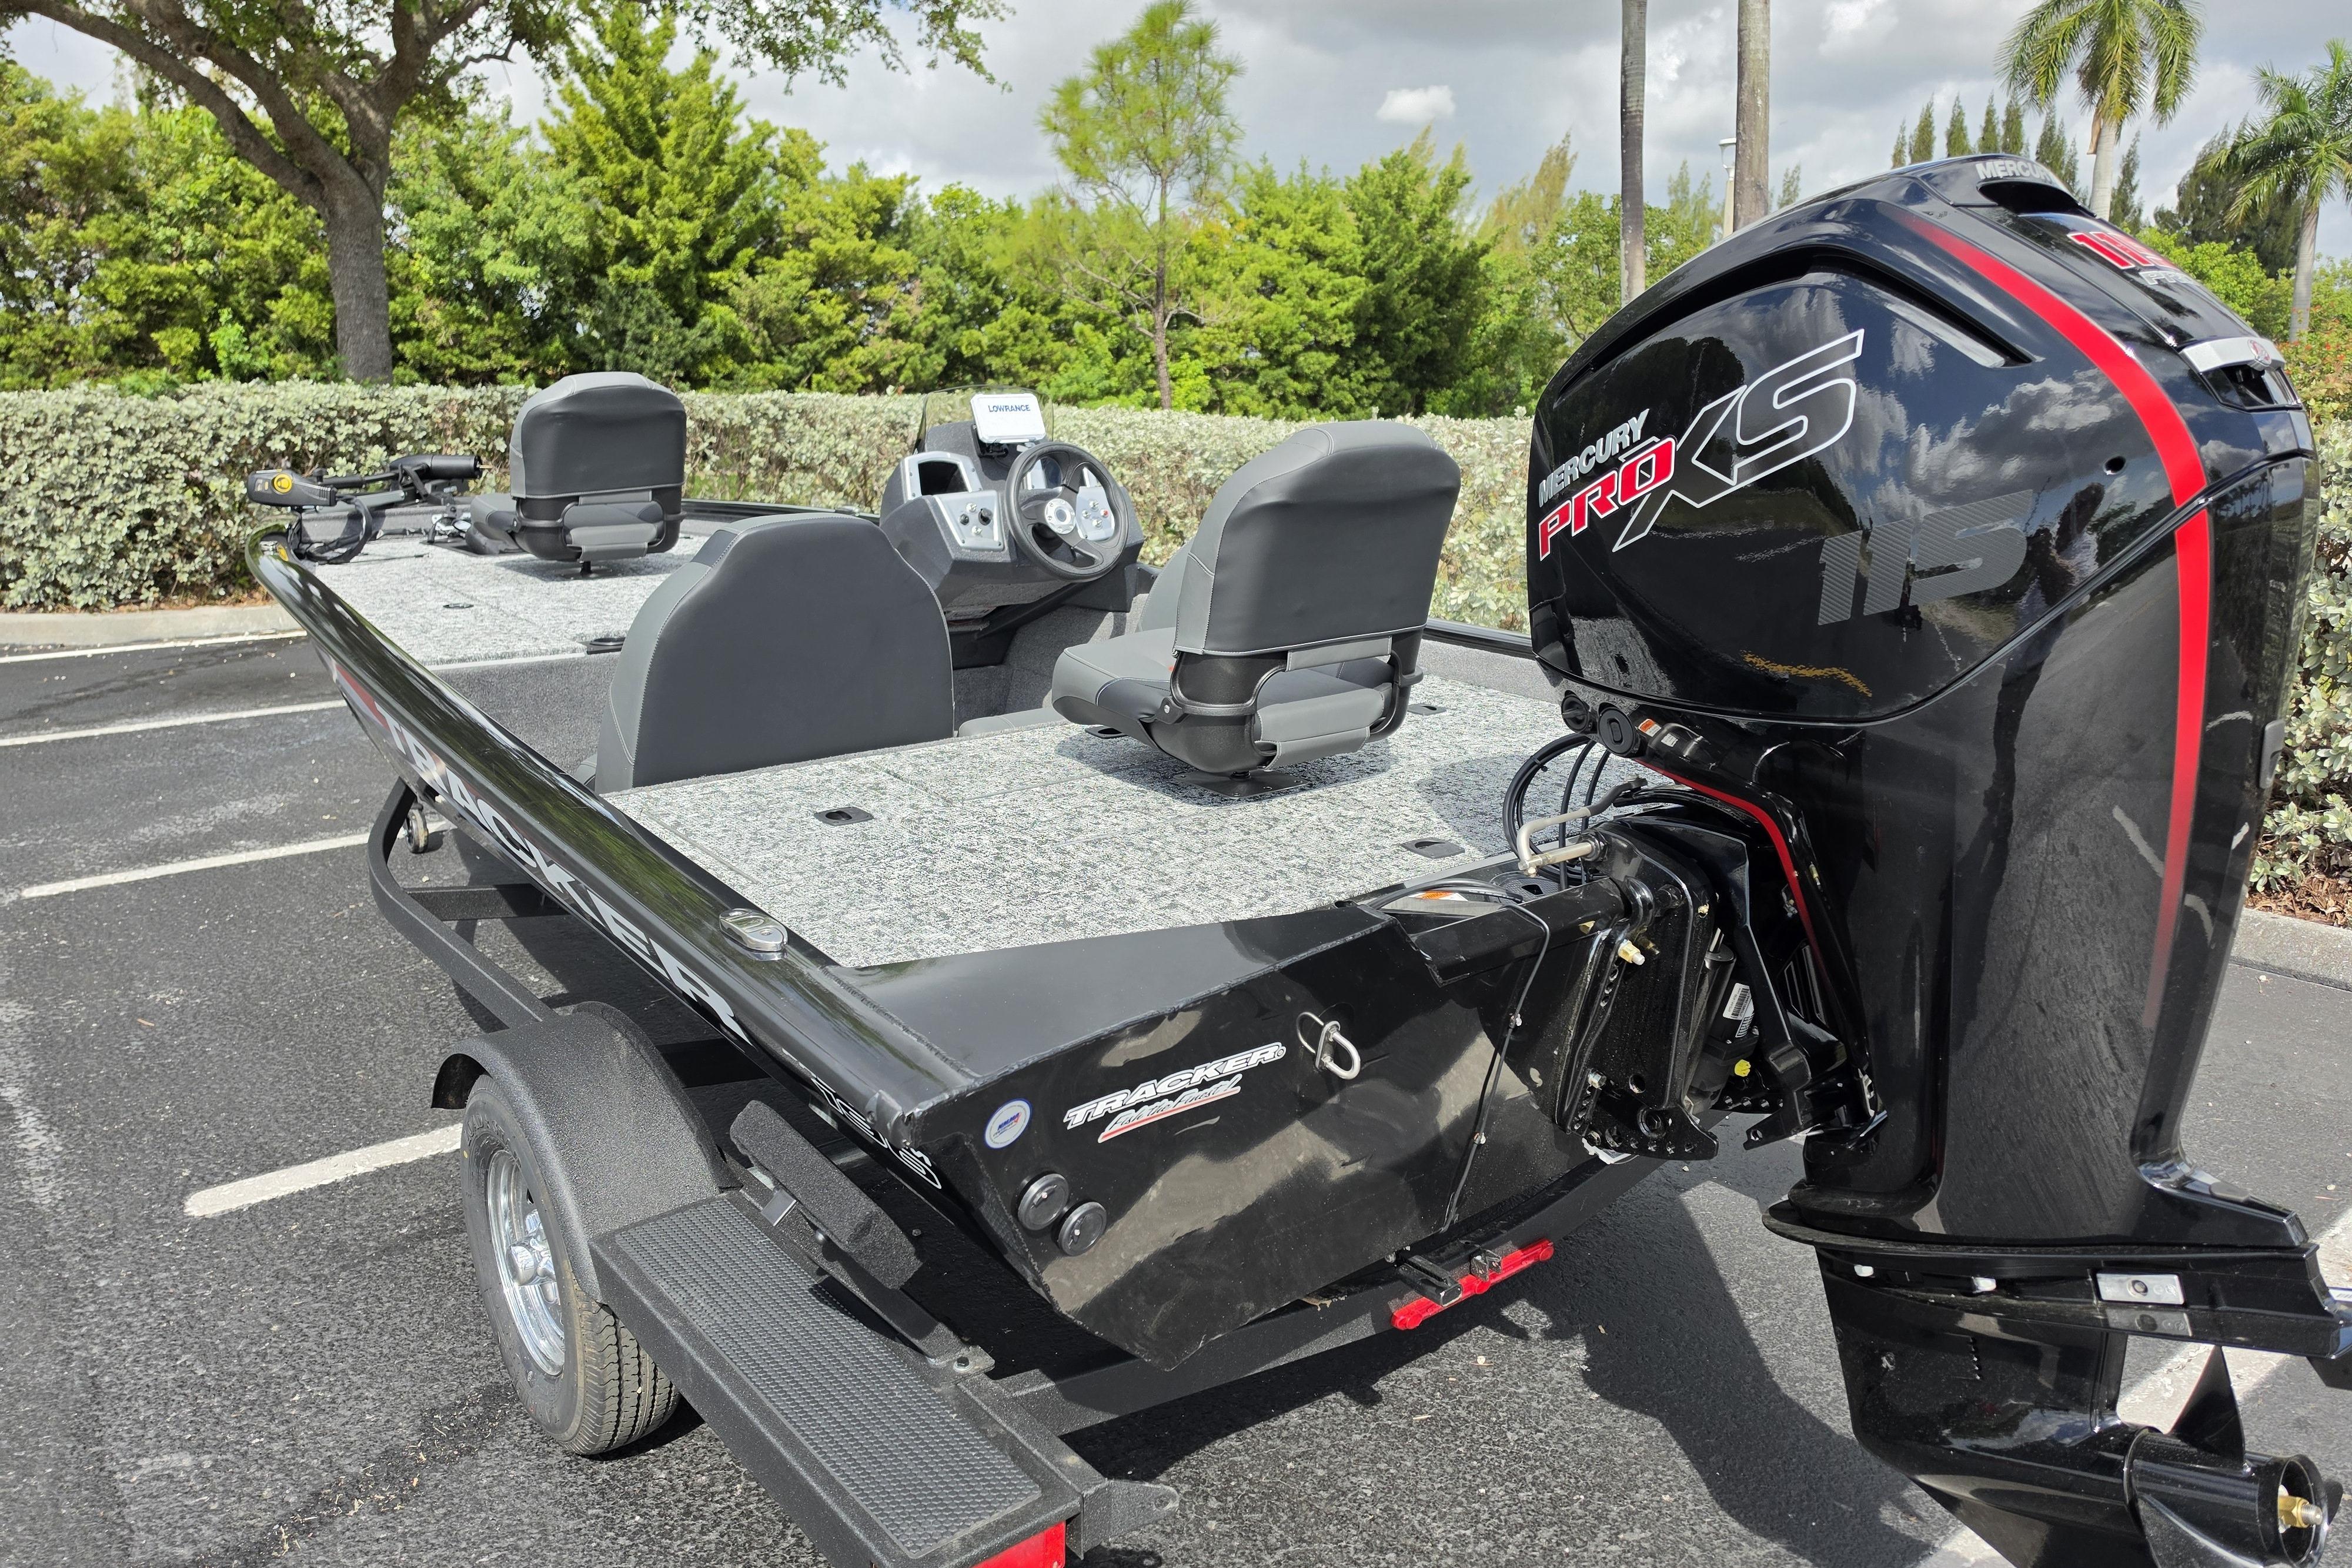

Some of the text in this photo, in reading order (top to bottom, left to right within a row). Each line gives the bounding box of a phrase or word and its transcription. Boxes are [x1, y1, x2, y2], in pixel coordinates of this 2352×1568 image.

[988, 404, 1031, 413] LOWRANCE
[1538, 328, 1865, 561] PRO XS
[1539, 408, 1650, 508] MERCURY
[1818, 489, 2033, 626] 115
[375, 700, 755, 1048] TRACKER
